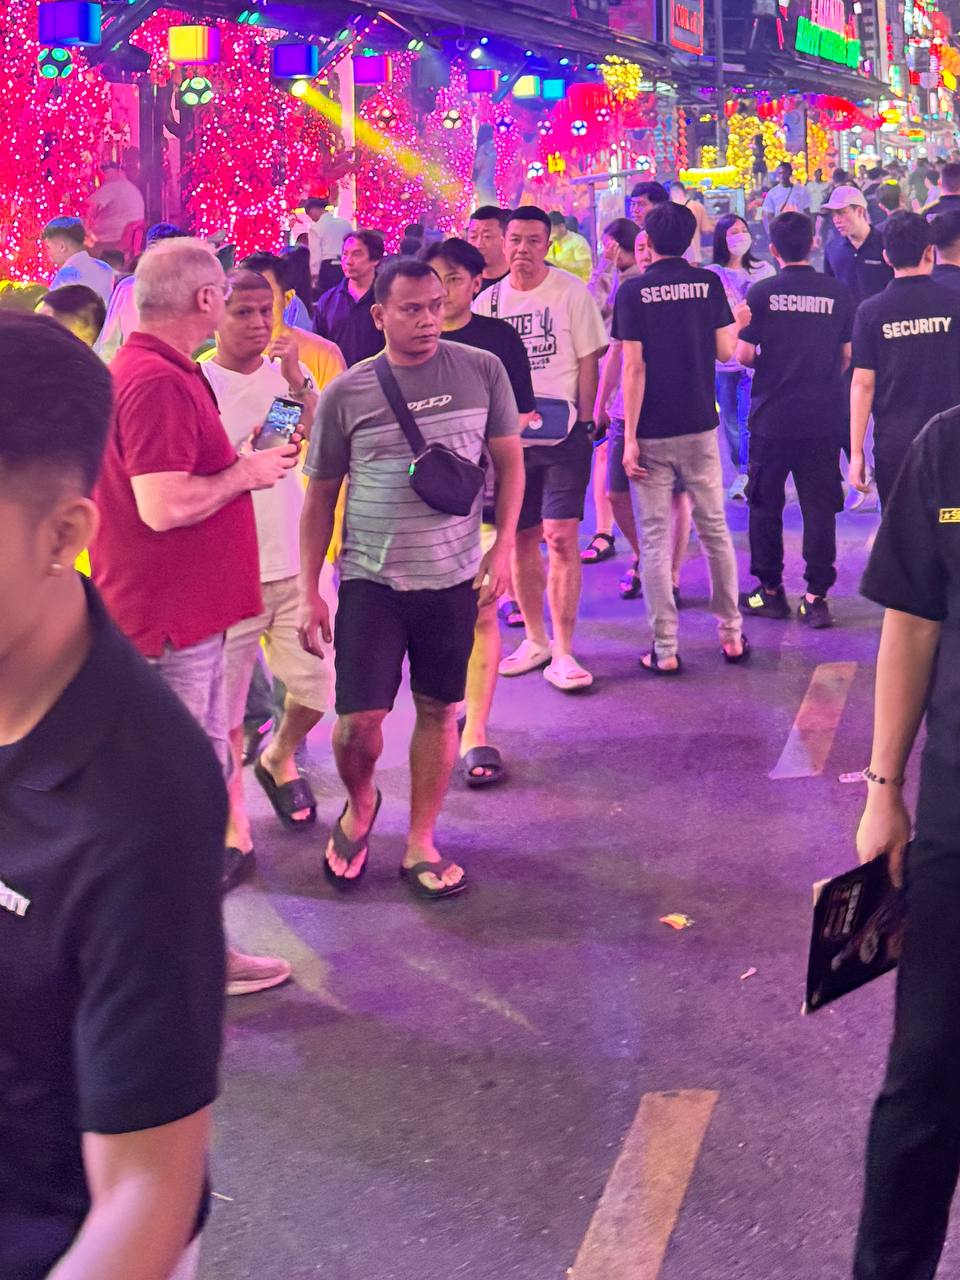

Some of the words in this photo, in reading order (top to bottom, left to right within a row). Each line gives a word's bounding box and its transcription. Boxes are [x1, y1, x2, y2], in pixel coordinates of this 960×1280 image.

[640, 282, 710, 304] SECURITY
[769, 294, 835, 314] SECURITY
[882, 317, 952, 339] SECURITY
